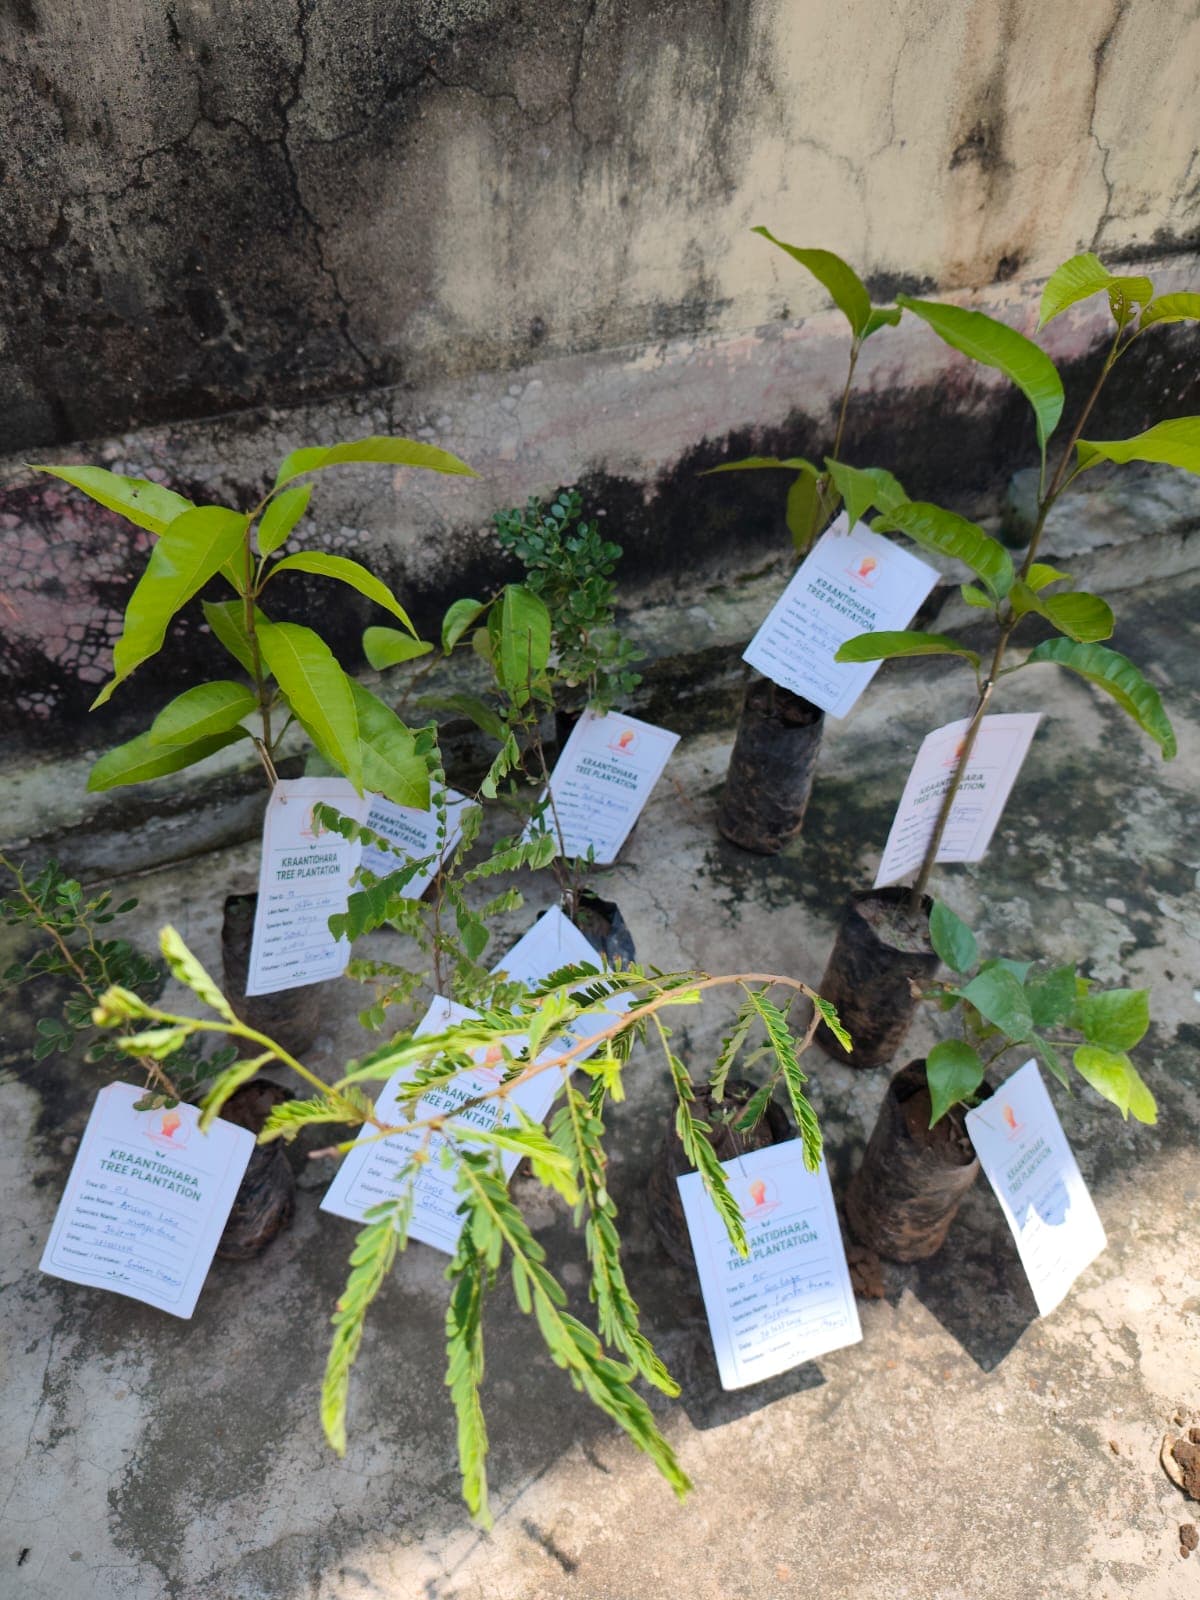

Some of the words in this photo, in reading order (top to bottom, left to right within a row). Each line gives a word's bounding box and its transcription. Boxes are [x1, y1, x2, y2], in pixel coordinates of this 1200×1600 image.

[807, 584, 825, 600] TREE
[826, 597, 875, 631] PLANTATION
[816, 578, 876, 619] KRAANTIDHARA
[575, 766, 591, 774] TREE
[276, 871, 295, 880] TREE
[297, 865, 340, 878] PLANTATION
[282, 853, 337, 867] KRAANTIDHARA
[423, 1092, 442, 1107] REE
[100, 1159, 129, 1174] TREE
[131, 1169, 202, 1201] PLANTATION
[110, 1149, 199, 1186] KRAANTIDHARA
[753, 1230, 817, 1259] PLANTATION
